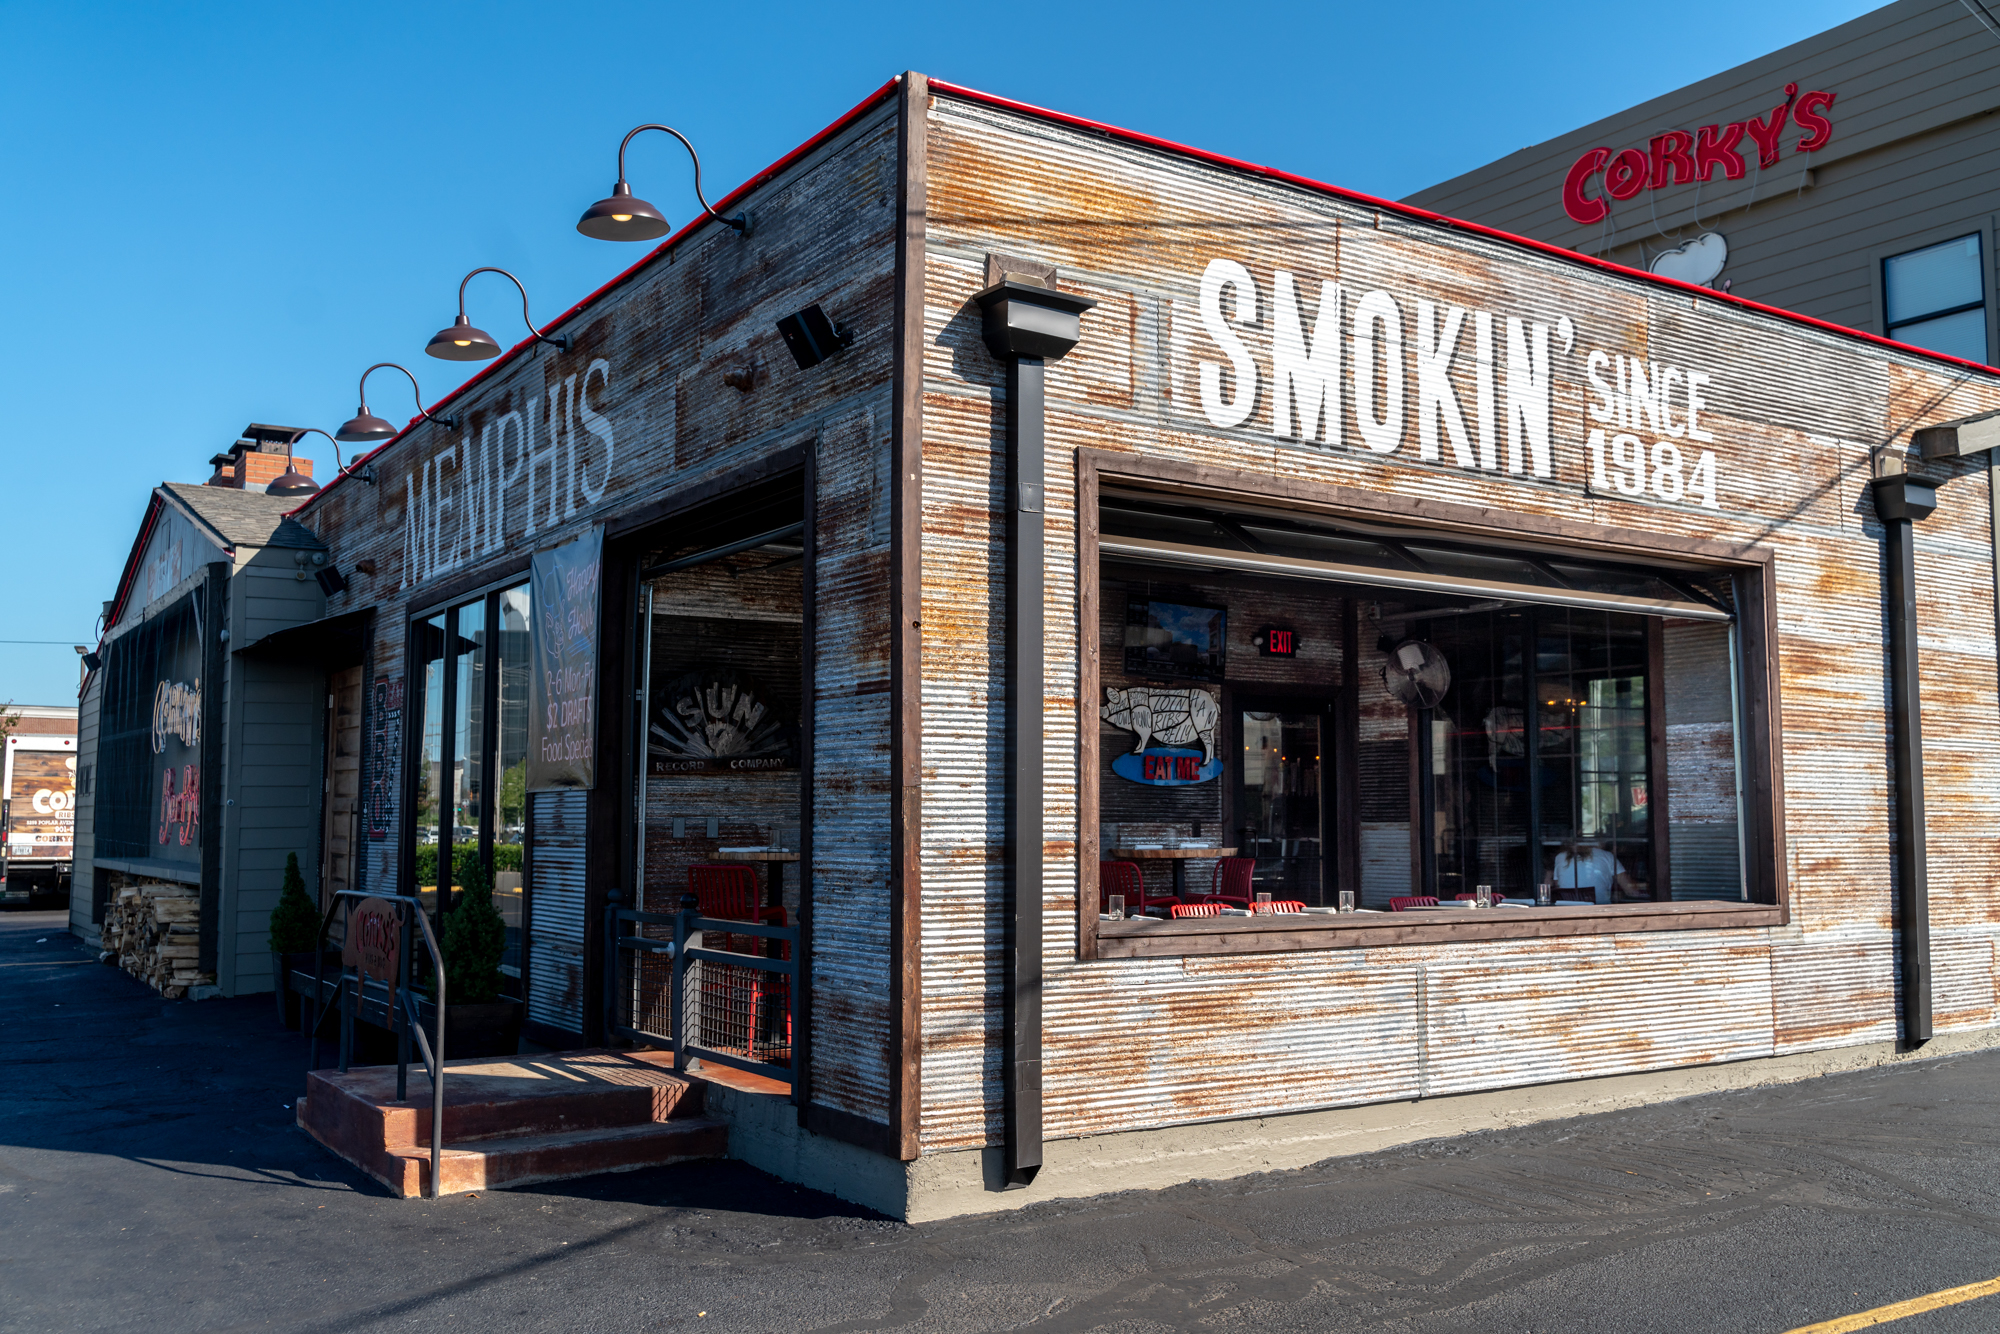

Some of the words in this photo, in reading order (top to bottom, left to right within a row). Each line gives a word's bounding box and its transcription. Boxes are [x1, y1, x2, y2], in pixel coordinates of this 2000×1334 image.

[1198, 258, 1578, 480] SMOKIN'
[1587, 350, 1712, 443] SINCE
[399, 358, 615, 590] MEMPHIS
[1585, 429, 1720, 511] 1984
[567, 558, 600, 603] Happy
[568, 601, 596, 641] Hour
[1270, 630, 1292, 653] EXIT
[547, 669, 563, 697] 2-6
[546, 699, 558, 733] $2
[561, 696, 593, 728] DRAFTS
[676, 686, 765, 731] SUN
[1153, 696, 1189, 712] LOIN
[1154, 713, 1181, 732] RIBS
[1190, 689, 1217, 729] HAM
[541, 737, 563, 763] Food
[1162, 725, 1193, 744] BELLY
[656, 760, 705, 772] RECORD
[730, 758, 786, 769] COMPANY
[1144, 755, 1173, 780] EAT
[1177, 757, 1201, 780] ME
